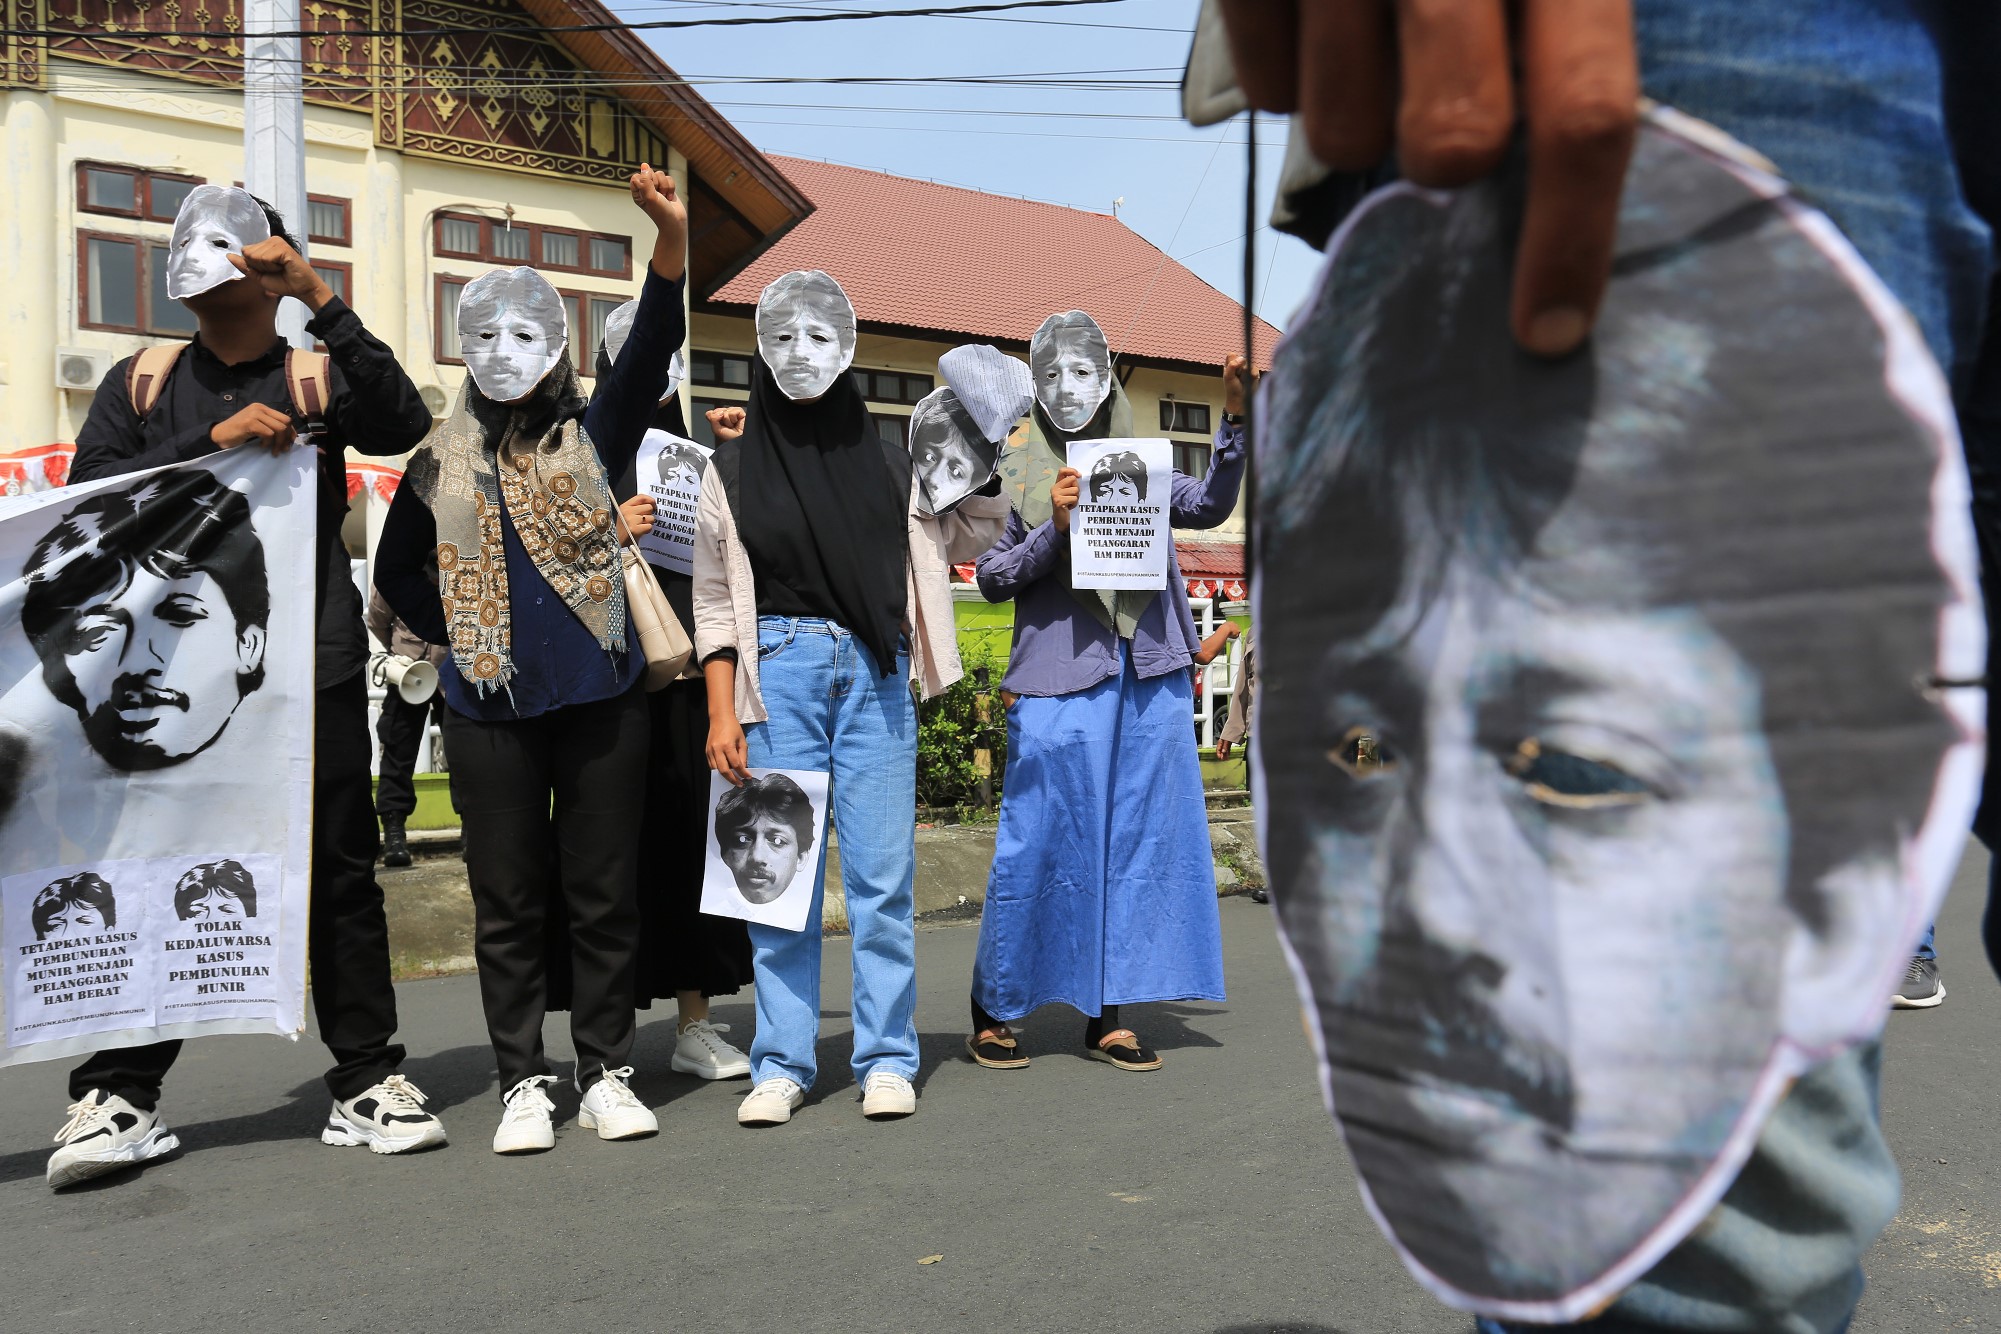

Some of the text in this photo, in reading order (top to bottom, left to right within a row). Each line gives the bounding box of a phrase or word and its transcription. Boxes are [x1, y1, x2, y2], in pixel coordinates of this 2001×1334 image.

[649, 484, 692, 501] TETAPKAN
[656, 497, 697, 513] PEMBUNU
[1079, 504, 1160, 515] TETAPKAN KASUS
[653, 518, 695, 535] PELANGGA
[1087, 516, 1152, 526] PEMBUNUHAN
[652, 529, 695, 546] HAM BERA
[1083, 527, 1155, 537] MUNIR MENJADI
[1087, 539, 1151, 548] PELANGGARAN
[1094, 550, 1145, 560] HAM BERAT
[194, 920, 243, 933] TOLAK
[19, 931, 138, 956] TETAPKAN KASUS
[164, 935, 272, 951] KEDALUWARSA
[33, 946, 127, 967] PEMBUNUHAN
[196, 951, 244, 964] KASUS
[26, 958, 134, 982] MUNIR MENJADI
[169, 966, 270, 982] PEMBUNUHAN
[33, 971, 129, 994] PELANGGARAN
[197, 982, 245, 995] MUNIR
[43, 986, 121, 1005] HAM BERAT
